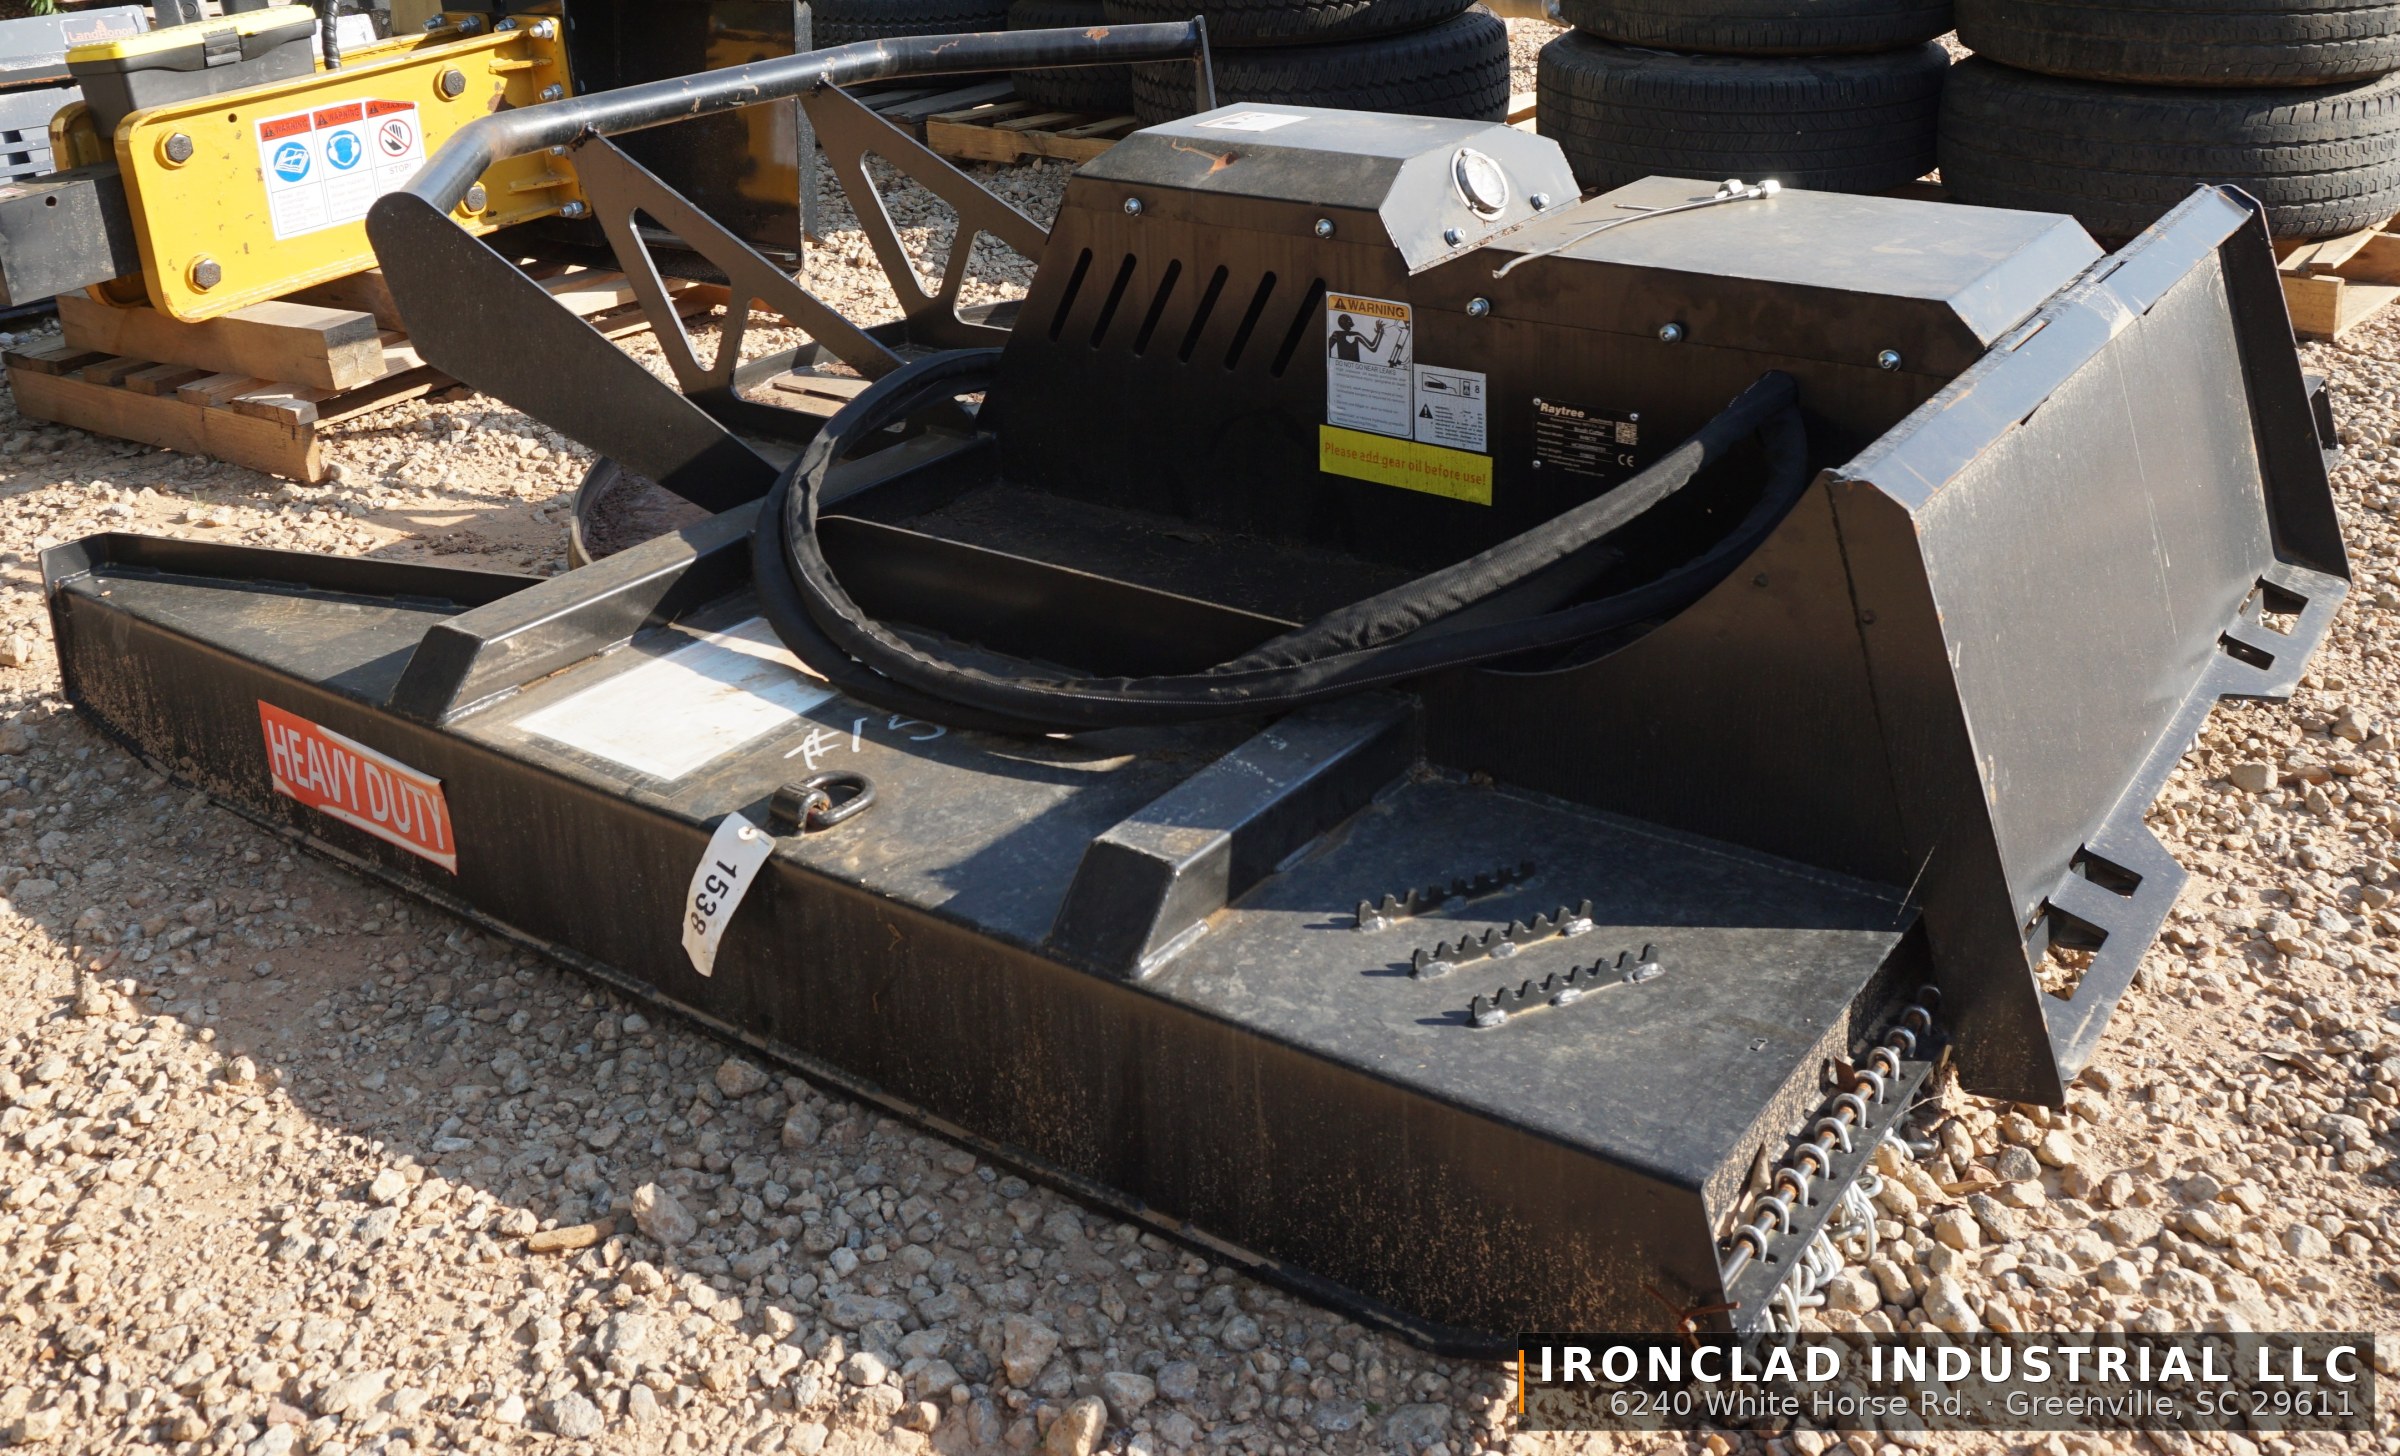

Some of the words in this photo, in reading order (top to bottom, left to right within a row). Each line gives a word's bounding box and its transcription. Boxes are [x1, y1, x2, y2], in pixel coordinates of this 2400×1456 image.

[328, 107, 361, 121] WARNING
[275, 118, 309, 133] WARNING
[389, 162, 412, 175] STOP!
[1348, 299, 1405, 318] WARNING
[1364, 364, 1379, 373] NEAR
[1540, 402, 1585, 418] Raytree
[1324, 441, 1358, 460] Please
[1359, 451, 1379, 464] add
[1382, 457, 1406, 469] gear
[1408, 460, 1422, 473] oil
[1424, 461, 1461, 481] before
[1463, 472, 1487, 486] use!
[267, 719, 359, 811] HEAVY
[363, 761, 445, 850] DUTY
[690, 860, 738, 936] 1538
